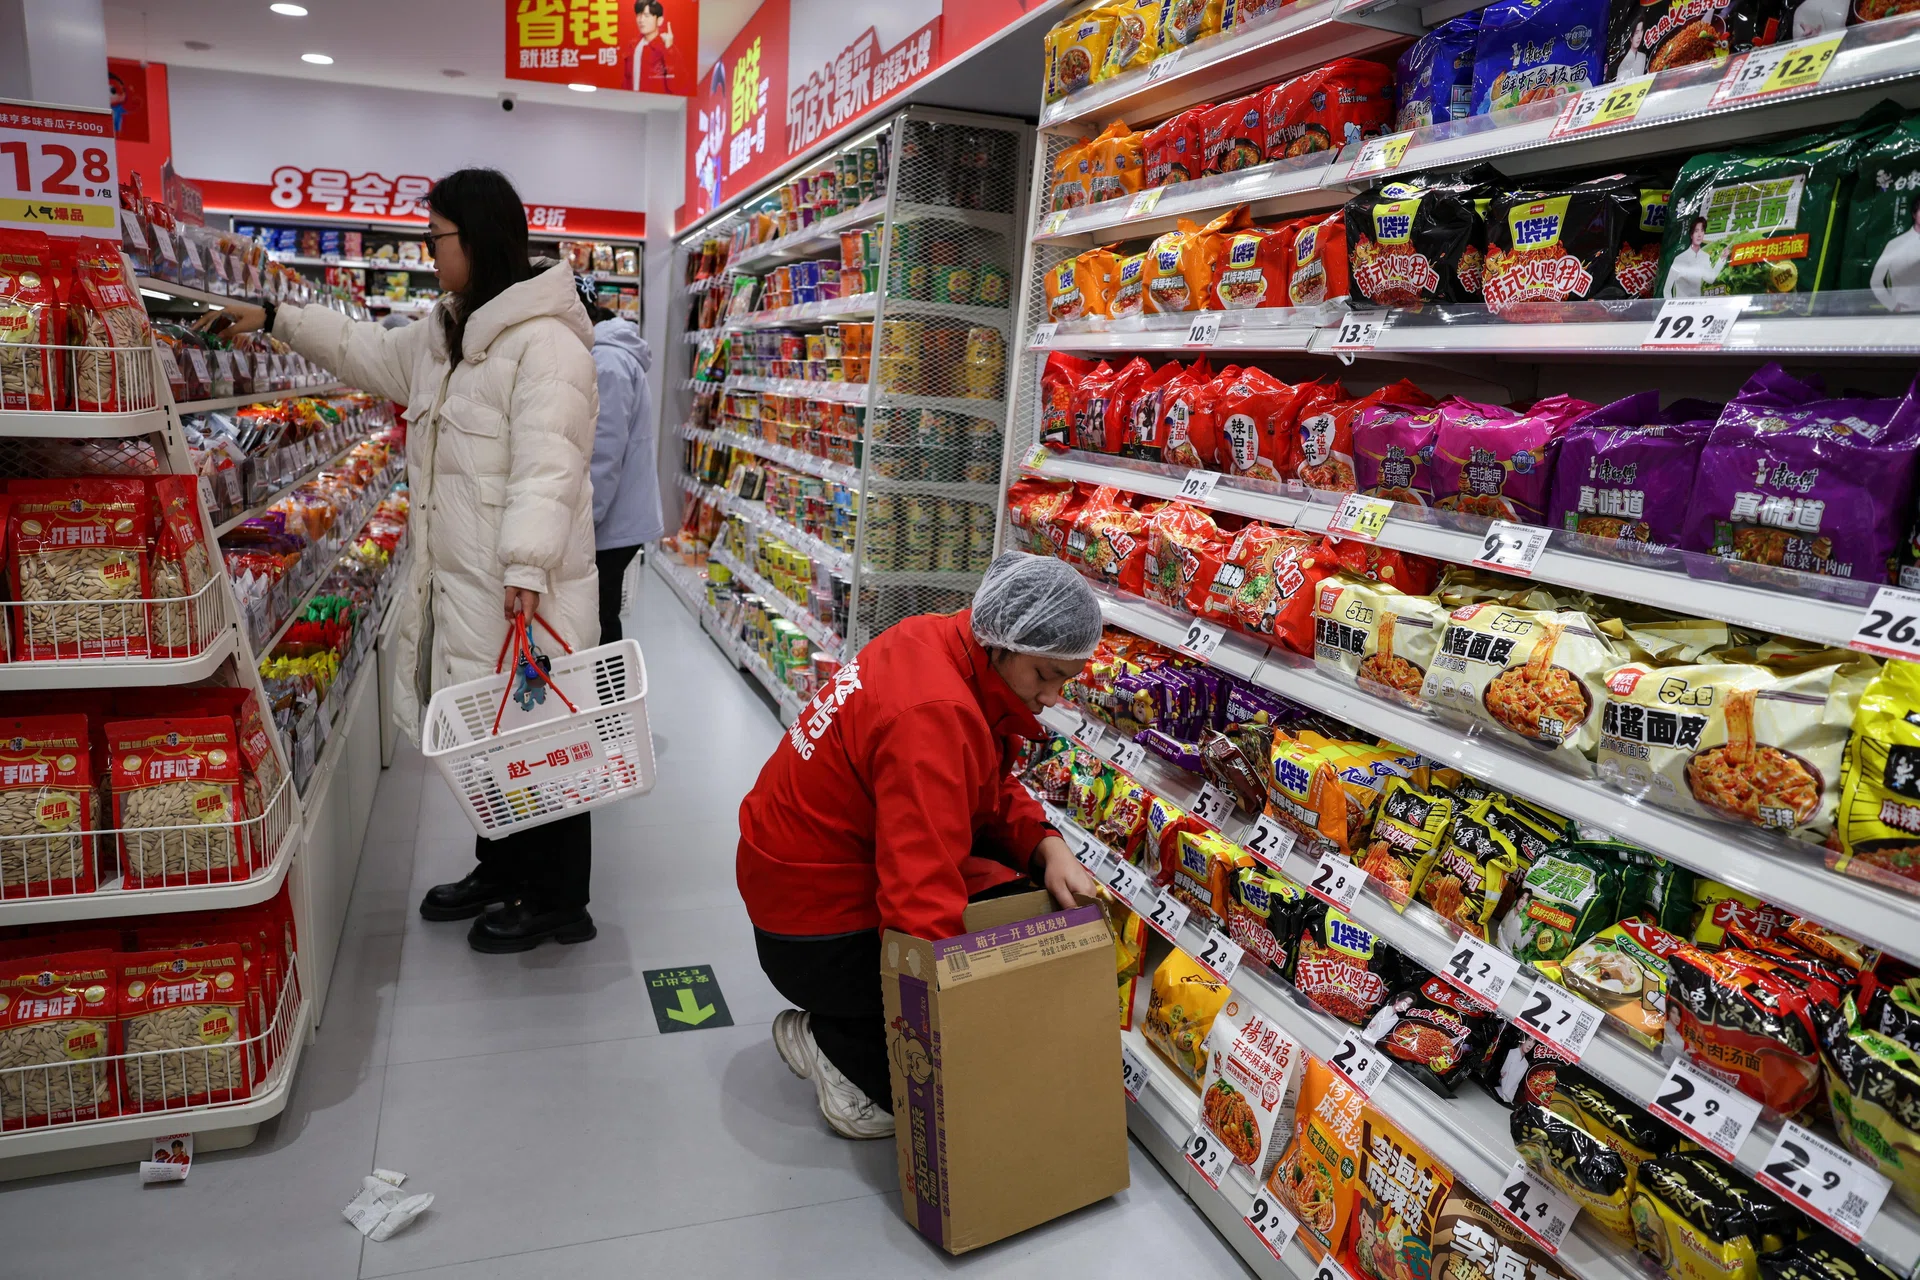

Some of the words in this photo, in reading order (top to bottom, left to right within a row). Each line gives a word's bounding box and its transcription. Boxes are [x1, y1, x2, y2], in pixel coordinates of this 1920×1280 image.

[517, 0, 618, 47] 省钱
[520, 47, 618, 68] 就逛赵一鸣
[872, 31, 931, 101] 省钱买大牌
[1523, 40, 1554, 64] 康师傅
[1779, 49, 1832, 79] 12.8
[731, 36, 761, 135] 省钱
[1501, 61, 1588, 95] 鲜虾鱼板面
[1740, 62, 1777, 81] 13.2
[1266, 121, 1306, 149] 红烧牛肉面
[24, 205, 84, 222] 人气爆品
[1377, 214, 1410, 239] 1袋半
[1706, 196, 1789, 234] 香菜面
[1514, 214, 1559, 245] 1袋半
[1232, 242, 1256, 264] 1袋半
[1298, 232, 1316, 262] 1袋半
[1734, 239, 1805, 262] 香辣牛肉汤底
[1222, 269, 1262, 285] 红烧牛肉面
[1292, 260, 1322, 285] 红烧牛肉面
[1354, 253, 1440, 297] 韩式火鸡拌面
[1483, 255, 1593, 314] 韩式火鸡拌面
[1188, 325, 1212, 342] 10.8
[1338, 323, 1371, 343] 13.5
[1654, 314, 1715, 339] 19.9
[1231, 418, 1247, 465] 辣白菜
[1316, 434, 1327, 456] 拉面
[1384, 461, 1412, 476] 老坛酸菜
[1385, 474, 1409, 487] 牛肉面
[1469, 466, 1502, 482] 老坛酸菜
[1599, 459, 1637, 486] 康师傅
[1771, 462, 1819, 493] 康师傅
[1472, 479, 1498, 494] 牛肉面
[51, 526, 107, 545] 打手瓜子
[1787, 536, 1812, 554] 老坛
[103, 561, 128, 576] 超值
[1274, 547, 1305, 598] 5+1袋
[1783, 551, 1853, 579] 酸菜牛肉面
[1187, 627, 1211, 651] 9.9
[1316, 618, 1368, 657] 麻酱面皮
[1441, 627, 1518, 667] 麻酱面皮
[1074, 718, 1094, 740] 2.4
[1538, 718, 1564, 737] 干拌
[1602, 702, 1711, 751] 麻酱面皮
[507, 749, 570, 780] 赵一鸣
[1110, 742, 1133, 765] 2.4
[150, 759, 201, 779] 打手瓜子
[1274, 757, 1310, 795] 1袋半
[41, 801, 68, 816] 超值
[196, 795, 222, 810] 超值
[1194, 791, 1219, 819] 5.5
[1270, 788, 1318, 827] 香辣牛肉面
[1758, 806, 1796, 830] 干拌
[1075, 841, 1097, 865] 2.2
[1249, 826, 1279, 856] 2.2
[1182, 843, 1209, 880] 1袋半
[1109, 868, 1133, 893] 2.2
[1174, 871, 1212, 905] 香辣牛肉面
[1311, 863, 1346, 895] 2.8
[1241, 881, 1271, 912] 1袋半
[1149, 899, 1175, 926] 2.2
[1716, 901, 1778, 938] 大骨
[975, 927, 1021, 949] 箱子一开
[1024, 916, 1068, 936] 老板发财
[1037, 933, 1067, 948] 油炸方便面
[1330, 919, 1373, 954] 1袋半
[1624, 918, 1679, 955] 大骨
[1200, 937, 1228, 968] 2.8
[1449, 948, 1492, 985] 4.2
[652, 975, 710, 987] 安全出口
[658, 969, 700, 978] EXIT
[153, 981, 208, 1004] 打手瓜子
[17, 997, 77, 1019] 打手瓜子
[1519, 990, 1572, 1035] 2.7
[202, 1017, 228, 1031] 超值
[68, 1031, 97, 1048] 超值
[1240, 1015, 1292, 1068] 楊國福
[1231, 1037, 1284, 1086] 干拌麻辣烫
[1333, 1038, 1368, 1075] 2.8
[933, 1030, 946, 1122] 认准统一是关键
[1655, 1073, 1721, 1125] 2.9
[911, 1107, 931, 1202] 老坛酸菜
[1194, 1135, 1217, 1168] 9.9
[903, 1152, 916, 1195] 统一
[937, 1127, 951, 1217] 老坛酸菜牛肉面
[1371, 1135, 1435, 1209] 李海龙
[1764, 1140, 1841, 1199] 2.9
[929, 1169, 941, 1207] 牛肉面
[1366, 1160, 1424, 1236] 麻辣烫
[1503, 1179, 1549, 1223] 4.4
[1249, 1198, 1280, 1234] 9.9
